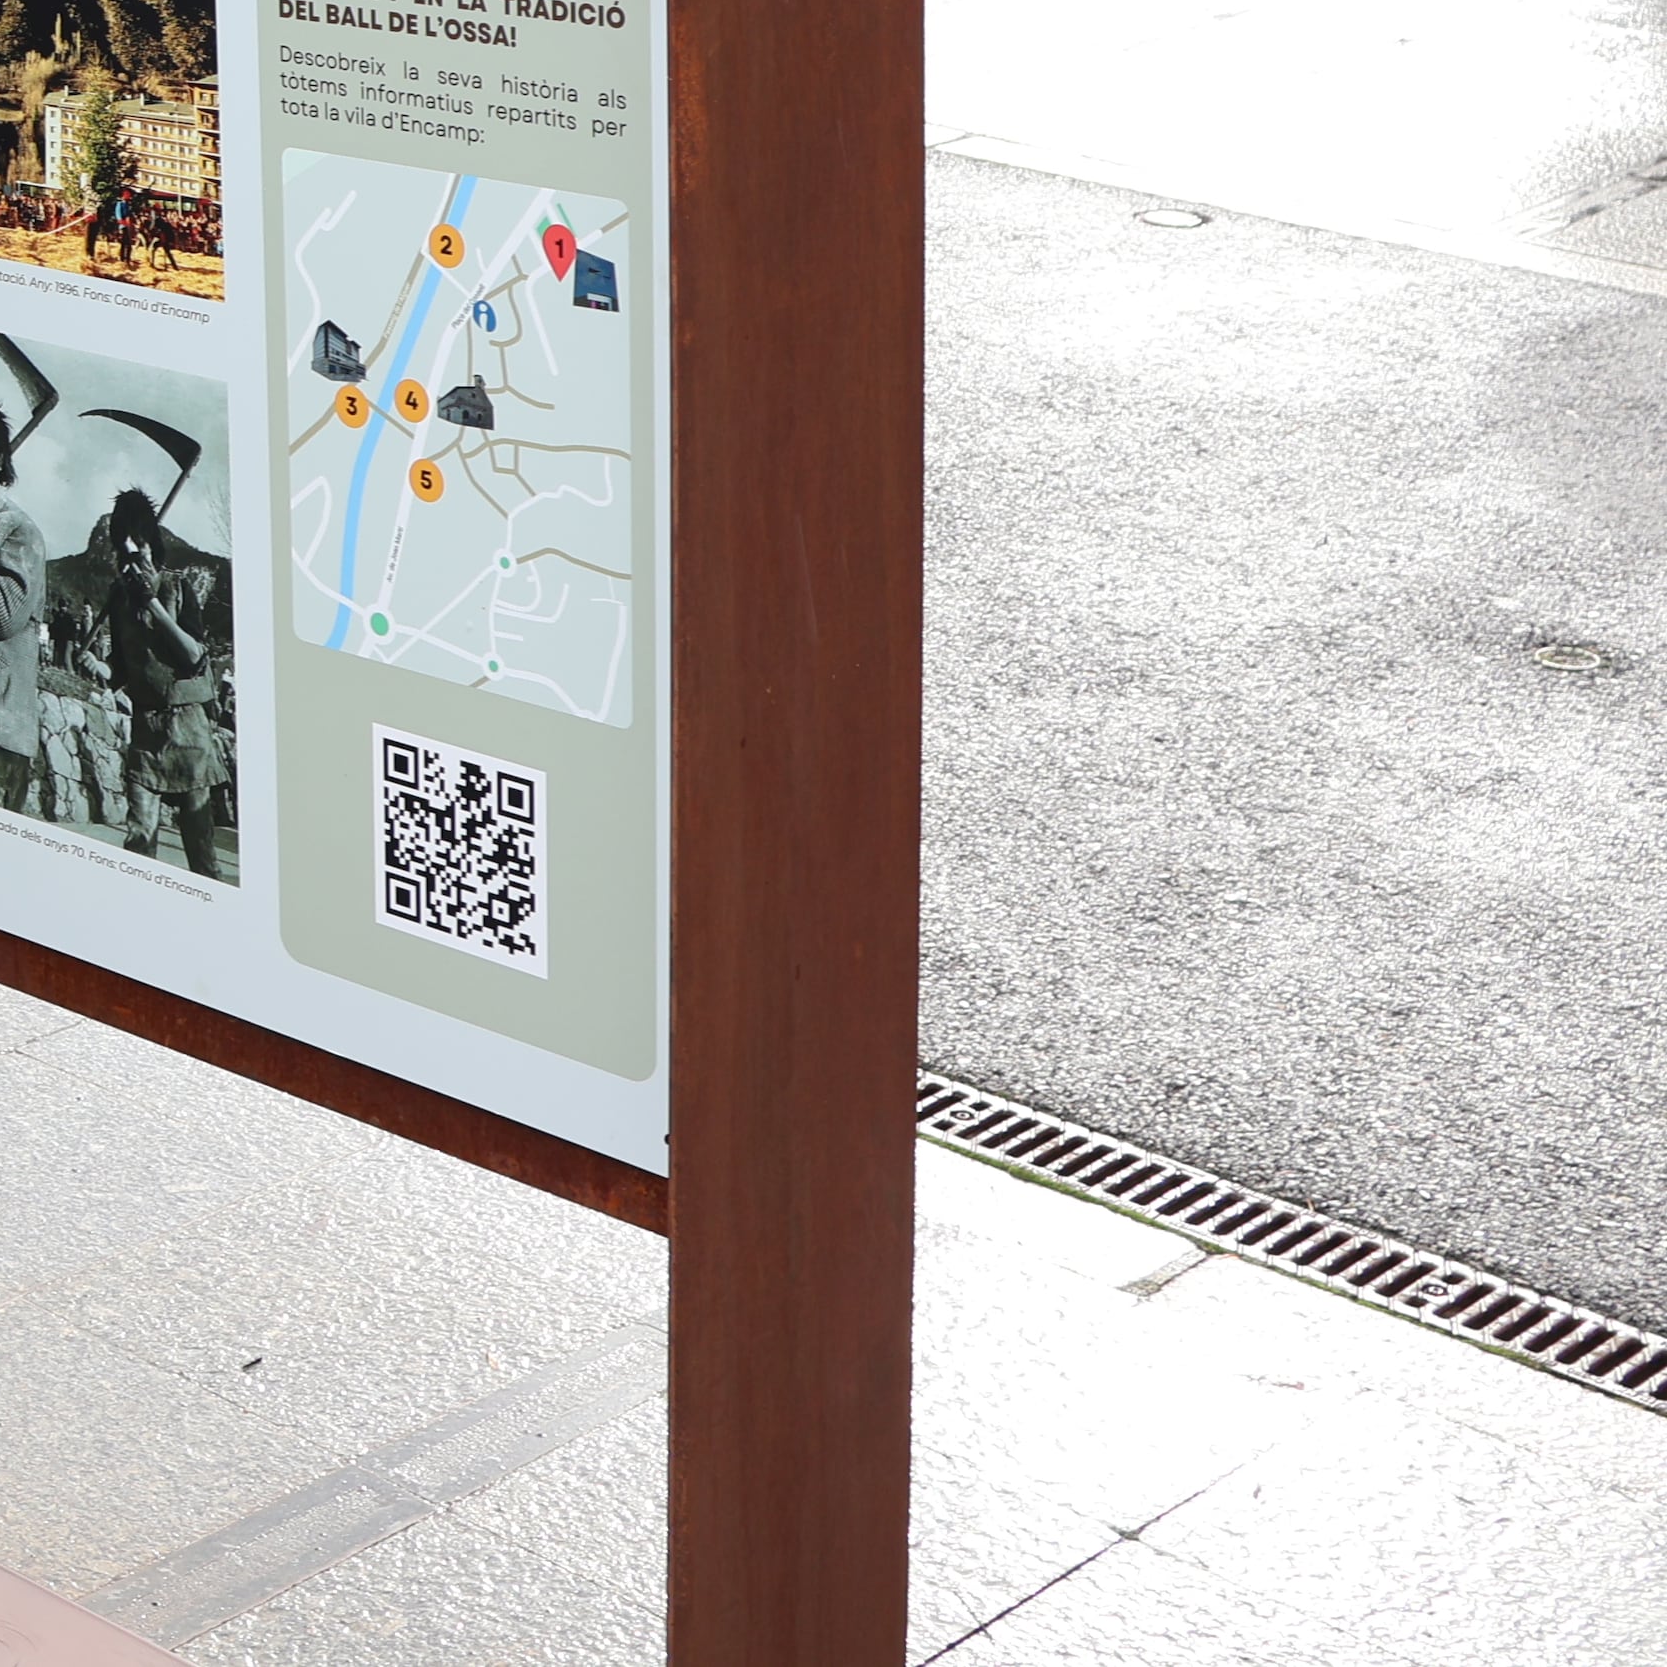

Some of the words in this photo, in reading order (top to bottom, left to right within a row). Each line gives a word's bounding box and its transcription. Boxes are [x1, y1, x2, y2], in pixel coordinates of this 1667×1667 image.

[326, 4, 383, 30] BALL
[388, 11, 418, 35] DE
[425, 16, 516, 47] L'OSSA!
[280, 45, 386, 76] Descobreix
[404, 61, 419, 80] la
[438, 71, 482, 89] seva
[502, 74, 578, 102] història
[598, 89, 626, 109] als
[280, 72, 347, 97] tòtems
[360, 81, 473, 115] informatius
[488, 105, 576, 130] repartits
[592, 119, 627, 137] per
[280, 98, 319, 118] tota
[325, 102, 339, 121] la
[344, 107, 376, 126] vila
[382, 111, 484, 146] d'Encamp:
[440, 236, 453, 256] 2
[555, 240, 564, 258] 1
[29, 277, 53, 293] Any:
[54, 280, 81, 297] 1996.
[84, 286, 111, 303] Fons:
[114, 292, 150, 311] Comú
[345, 396, 359, 415] 3
[405, 391, 418, 410] 4
[420, 470, 433, 489] 5
